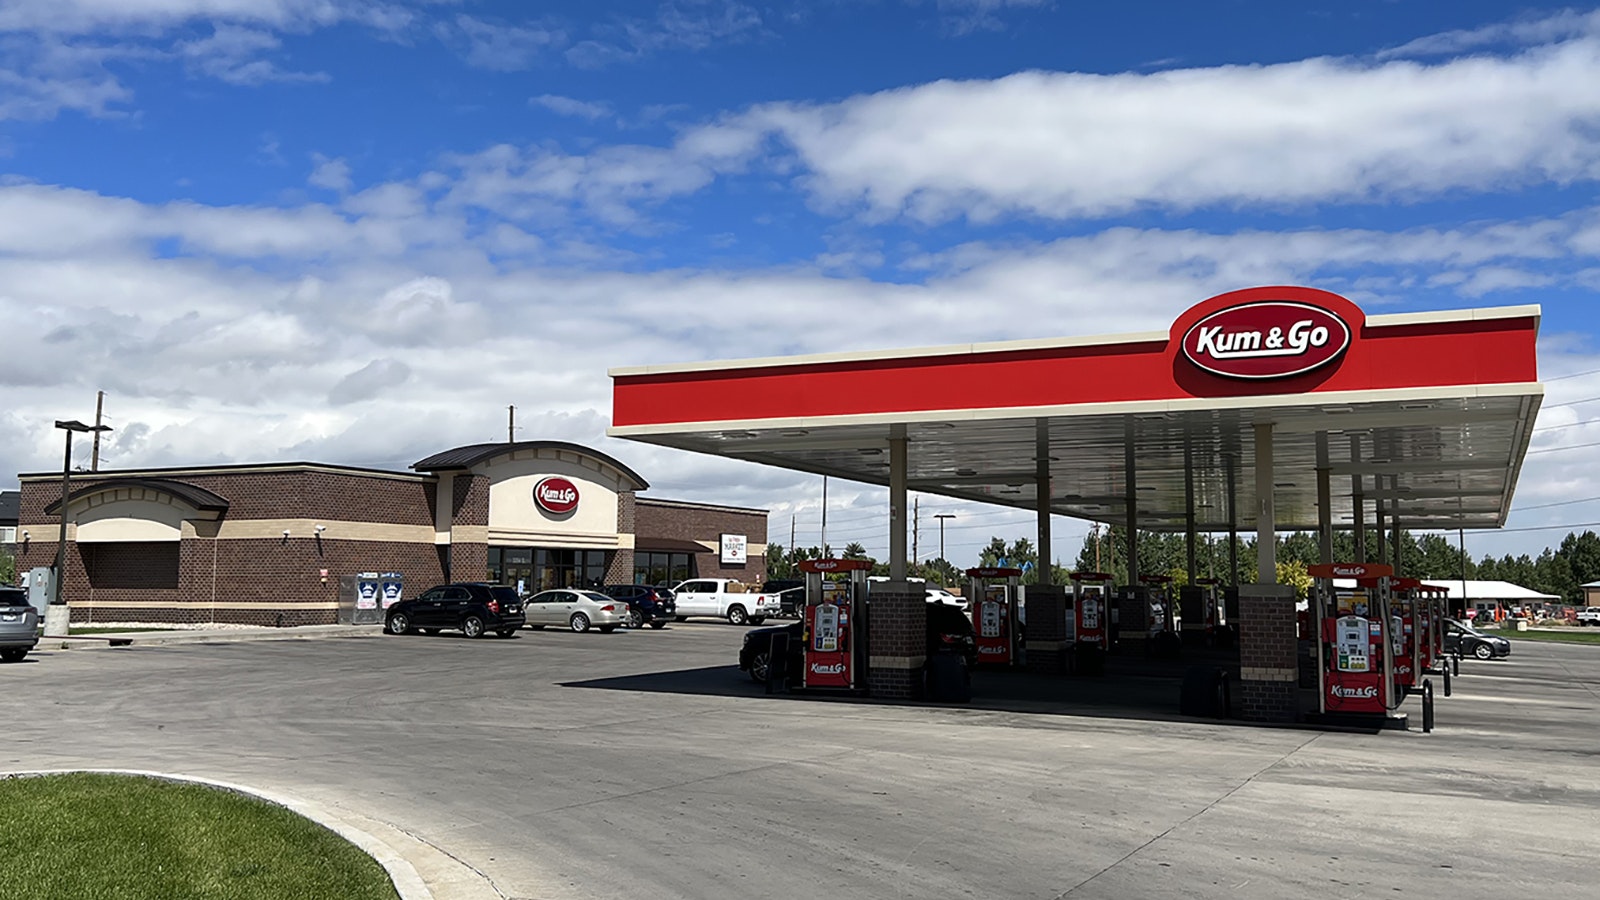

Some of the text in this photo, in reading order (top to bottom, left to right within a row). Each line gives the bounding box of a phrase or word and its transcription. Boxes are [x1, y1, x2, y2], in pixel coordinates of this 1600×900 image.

[1196, 320, 1329, 358] Kum & Go
[540, 485, 576, 504] Kum & Go
[1333, 567, 1349, 575] Kum
[1354, 567, 1365, 575] Go
[811, 662, 829, 674] Kum
[1331, 685, 1355, 697] Kum
[1356, 688, 1363, 696] &
